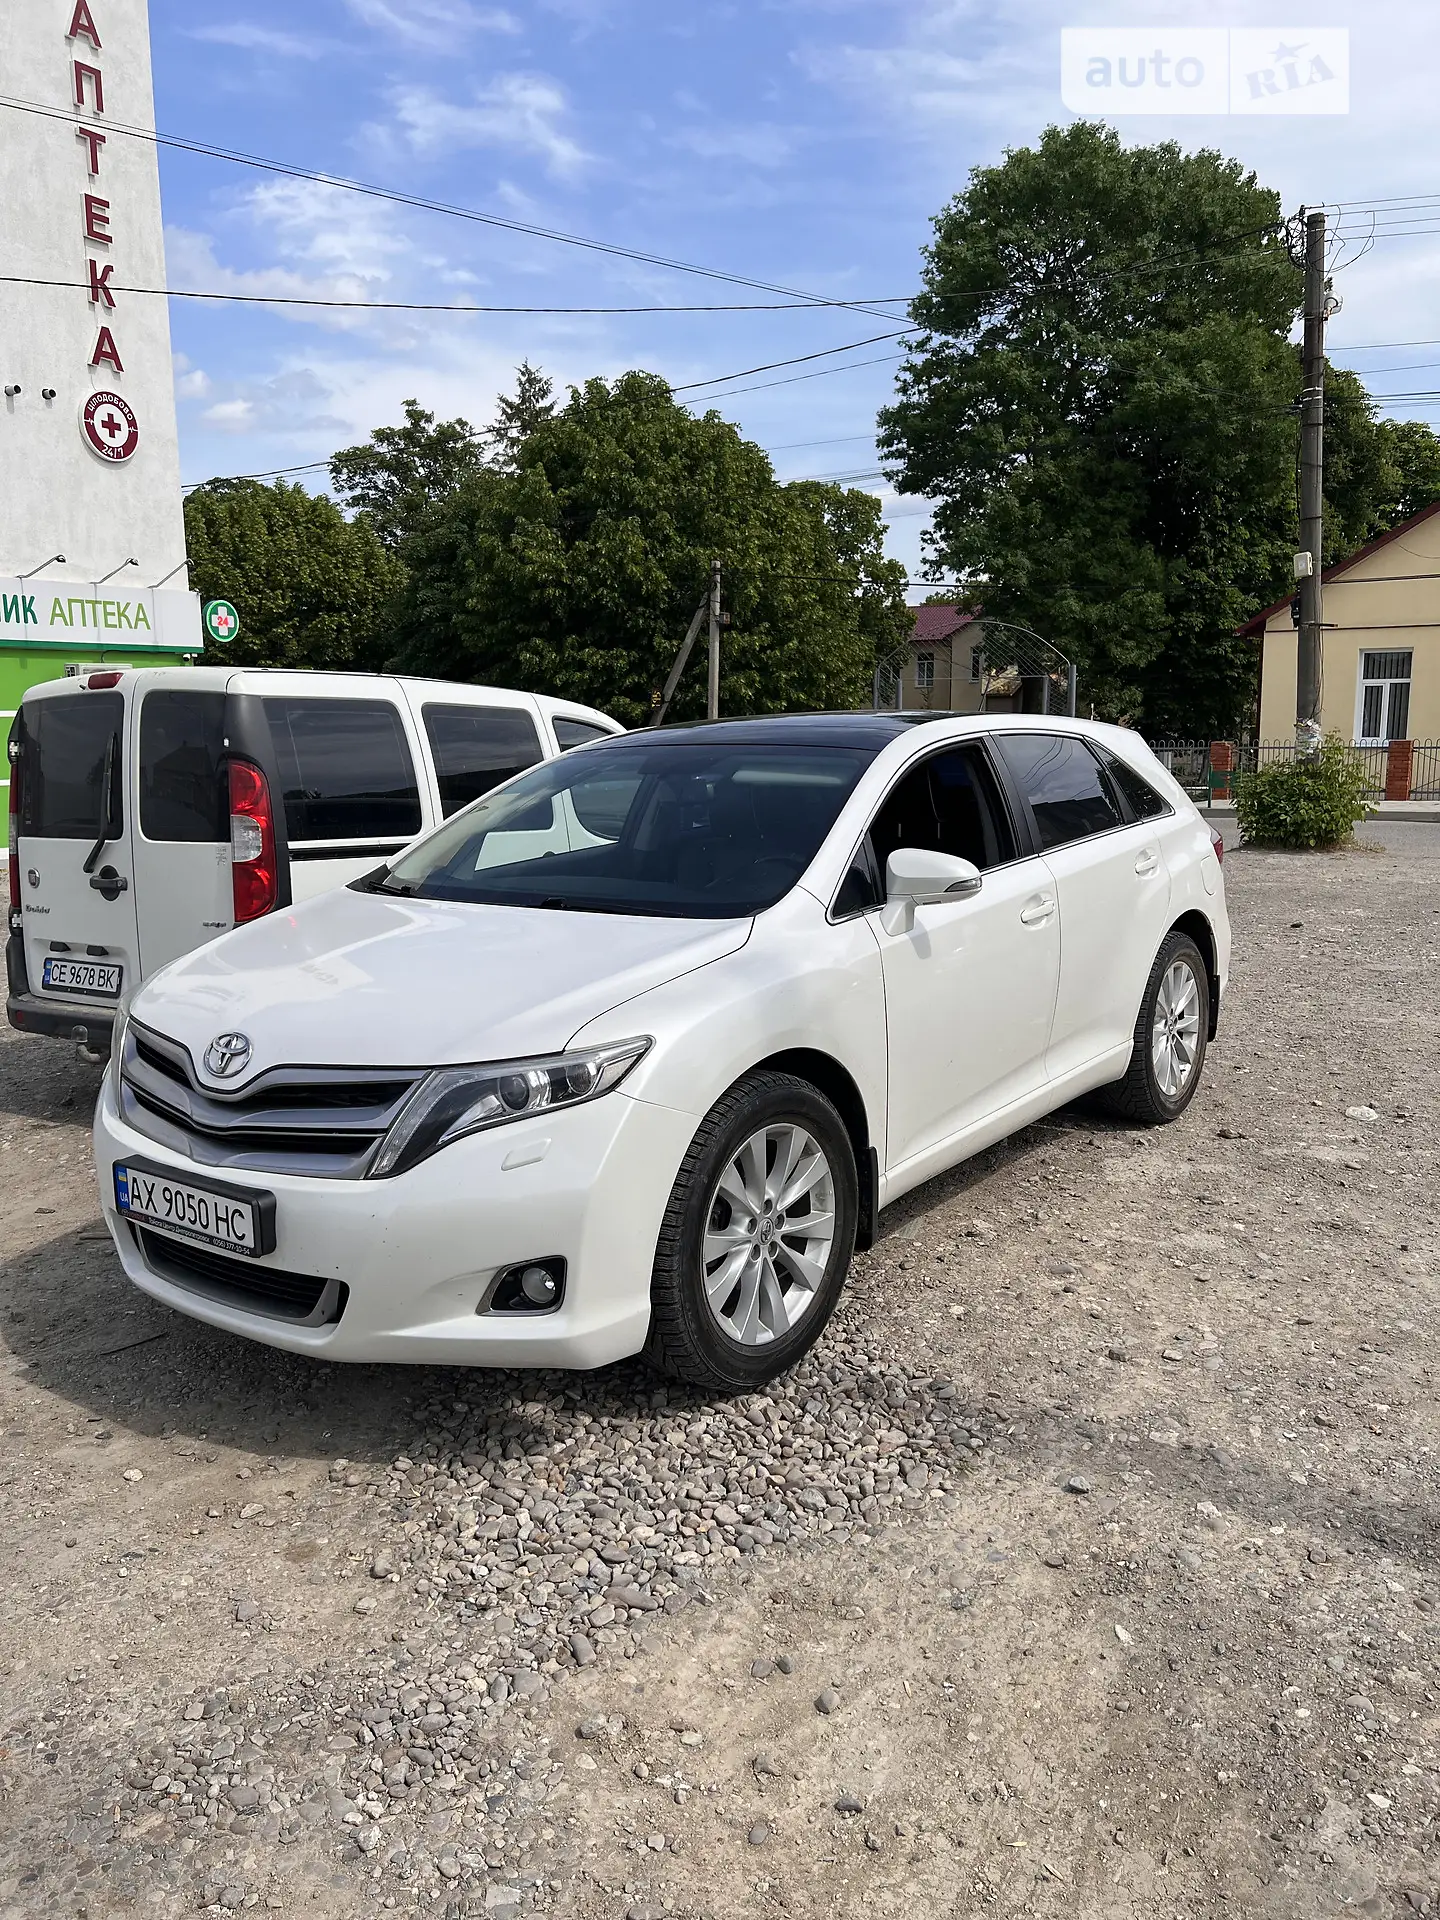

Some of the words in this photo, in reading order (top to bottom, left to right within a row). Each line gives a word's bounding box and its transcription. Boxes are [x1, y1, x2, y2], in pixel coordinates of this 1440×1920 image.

[67, 0, 124, 373] АПТЕКА
[87, 393, 133, 420] ЦІЛОДОБОВО
[102, 444, 124, 459] 24/7
[0, 593, 38, 624] ИК
[50, 597, 151, 630] АПТЕКА
[217, 615, 229, 627] 24
[51, 964, 67, 982] CE
[69, 966, 95, 986] 9678
[98, 969, 115, 988] BK
[120, 1191, 129, 1203] UA
[131, 1176, 158, 1213] AX
[162, 1186, 209, 1230] 9050
[214, 1201, 246, 1241] HC
